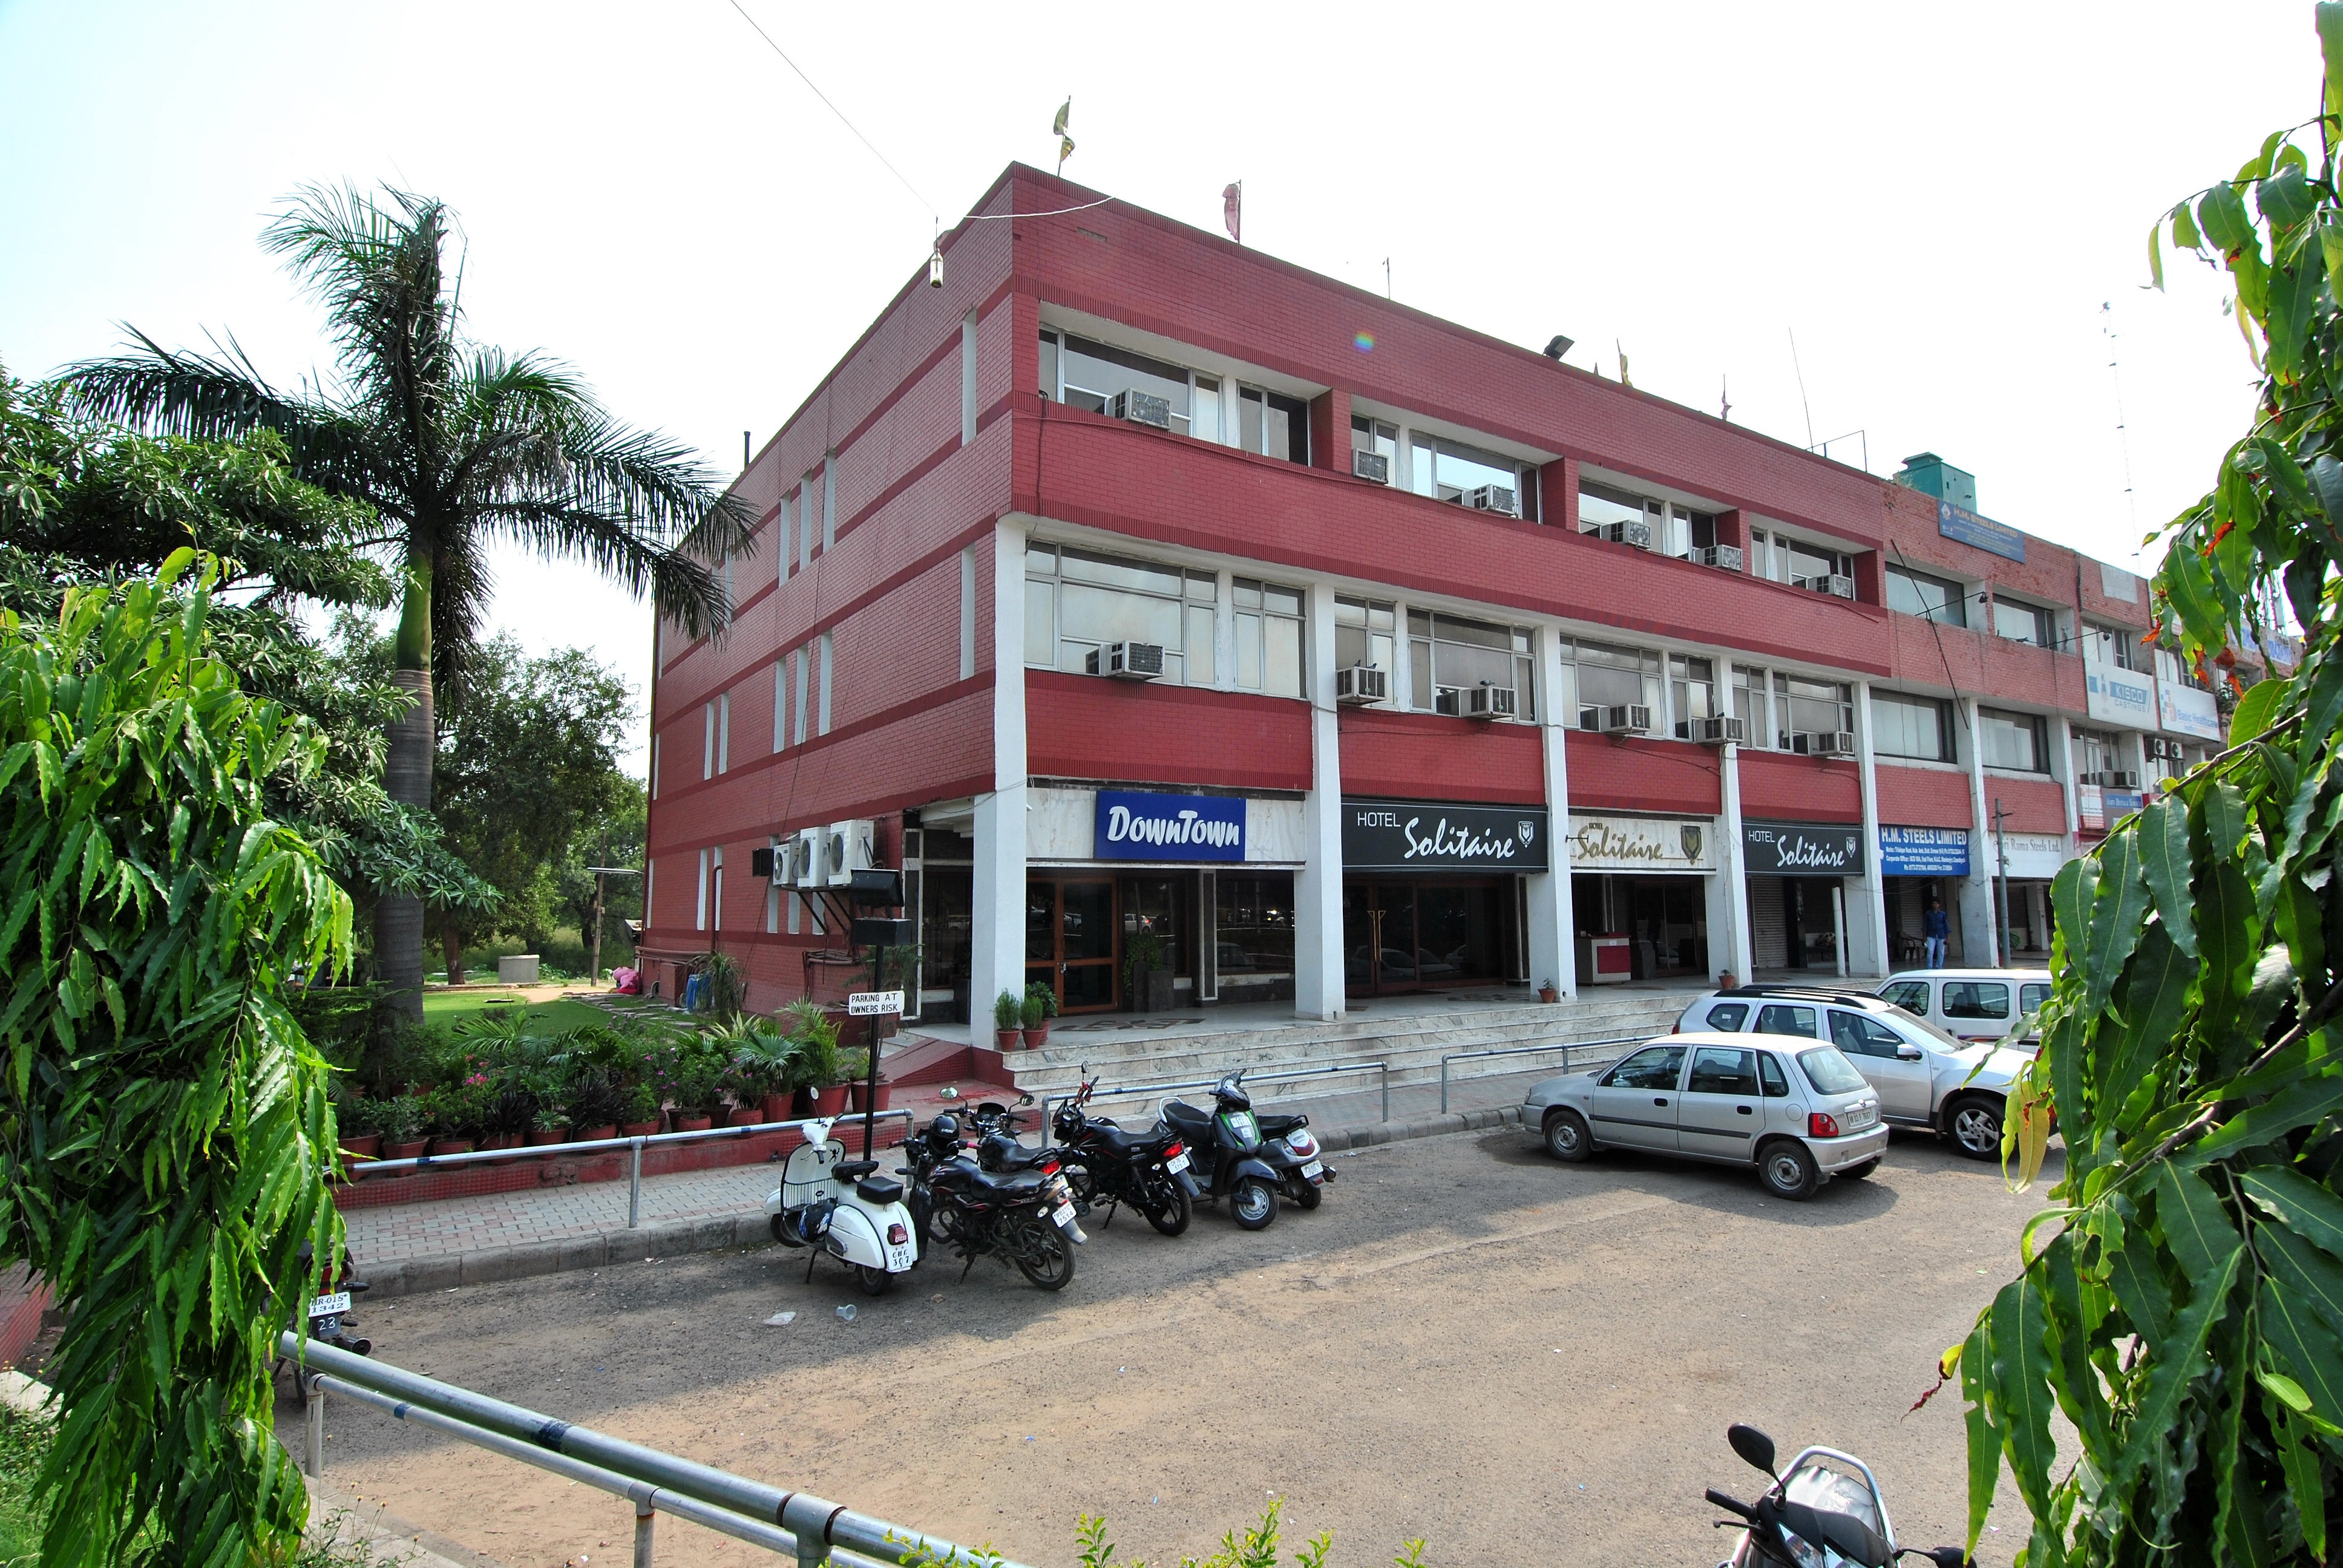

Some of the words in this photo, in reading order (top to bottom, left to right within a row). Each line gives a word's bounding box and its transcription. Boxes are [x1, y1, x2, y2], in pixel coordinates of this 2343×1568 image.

[2115, 684, 2143, 702] KISCO
[2114, 699, 2146, 713] CASTINGS
[1357, 812, 1401, 828] HOTEL
[1404, 817, 1515, 859] Solitaire
[1578, 825, 1663, 860] Solitaire
[1881, 827, 1901, 843] H.M.
[1902, 828, 1935, 844] STEELS
[1936, 830, 1967, 845] LIMITED
[1748, 830, 1775, 843] HOTEL
[1777, 835, 1844, 867] Solitaire
[2011, 838, 2028, 852] Rama
[2030, 838, 2047, 852] Steels
[2048, 840, 2060, 852] Ltd.
[851, 994, 879, 1003] PARKING
[885, 993, 897, 1002] AT
[851, 1005, 879, 1014] OWNERS
[881, 1004, 898, 1012] RISK
[1058, 1210, 1073, 1224] 7514
[312, 1302, 344, 1313] 1342
[318, 1316, 335, 1331] 23
